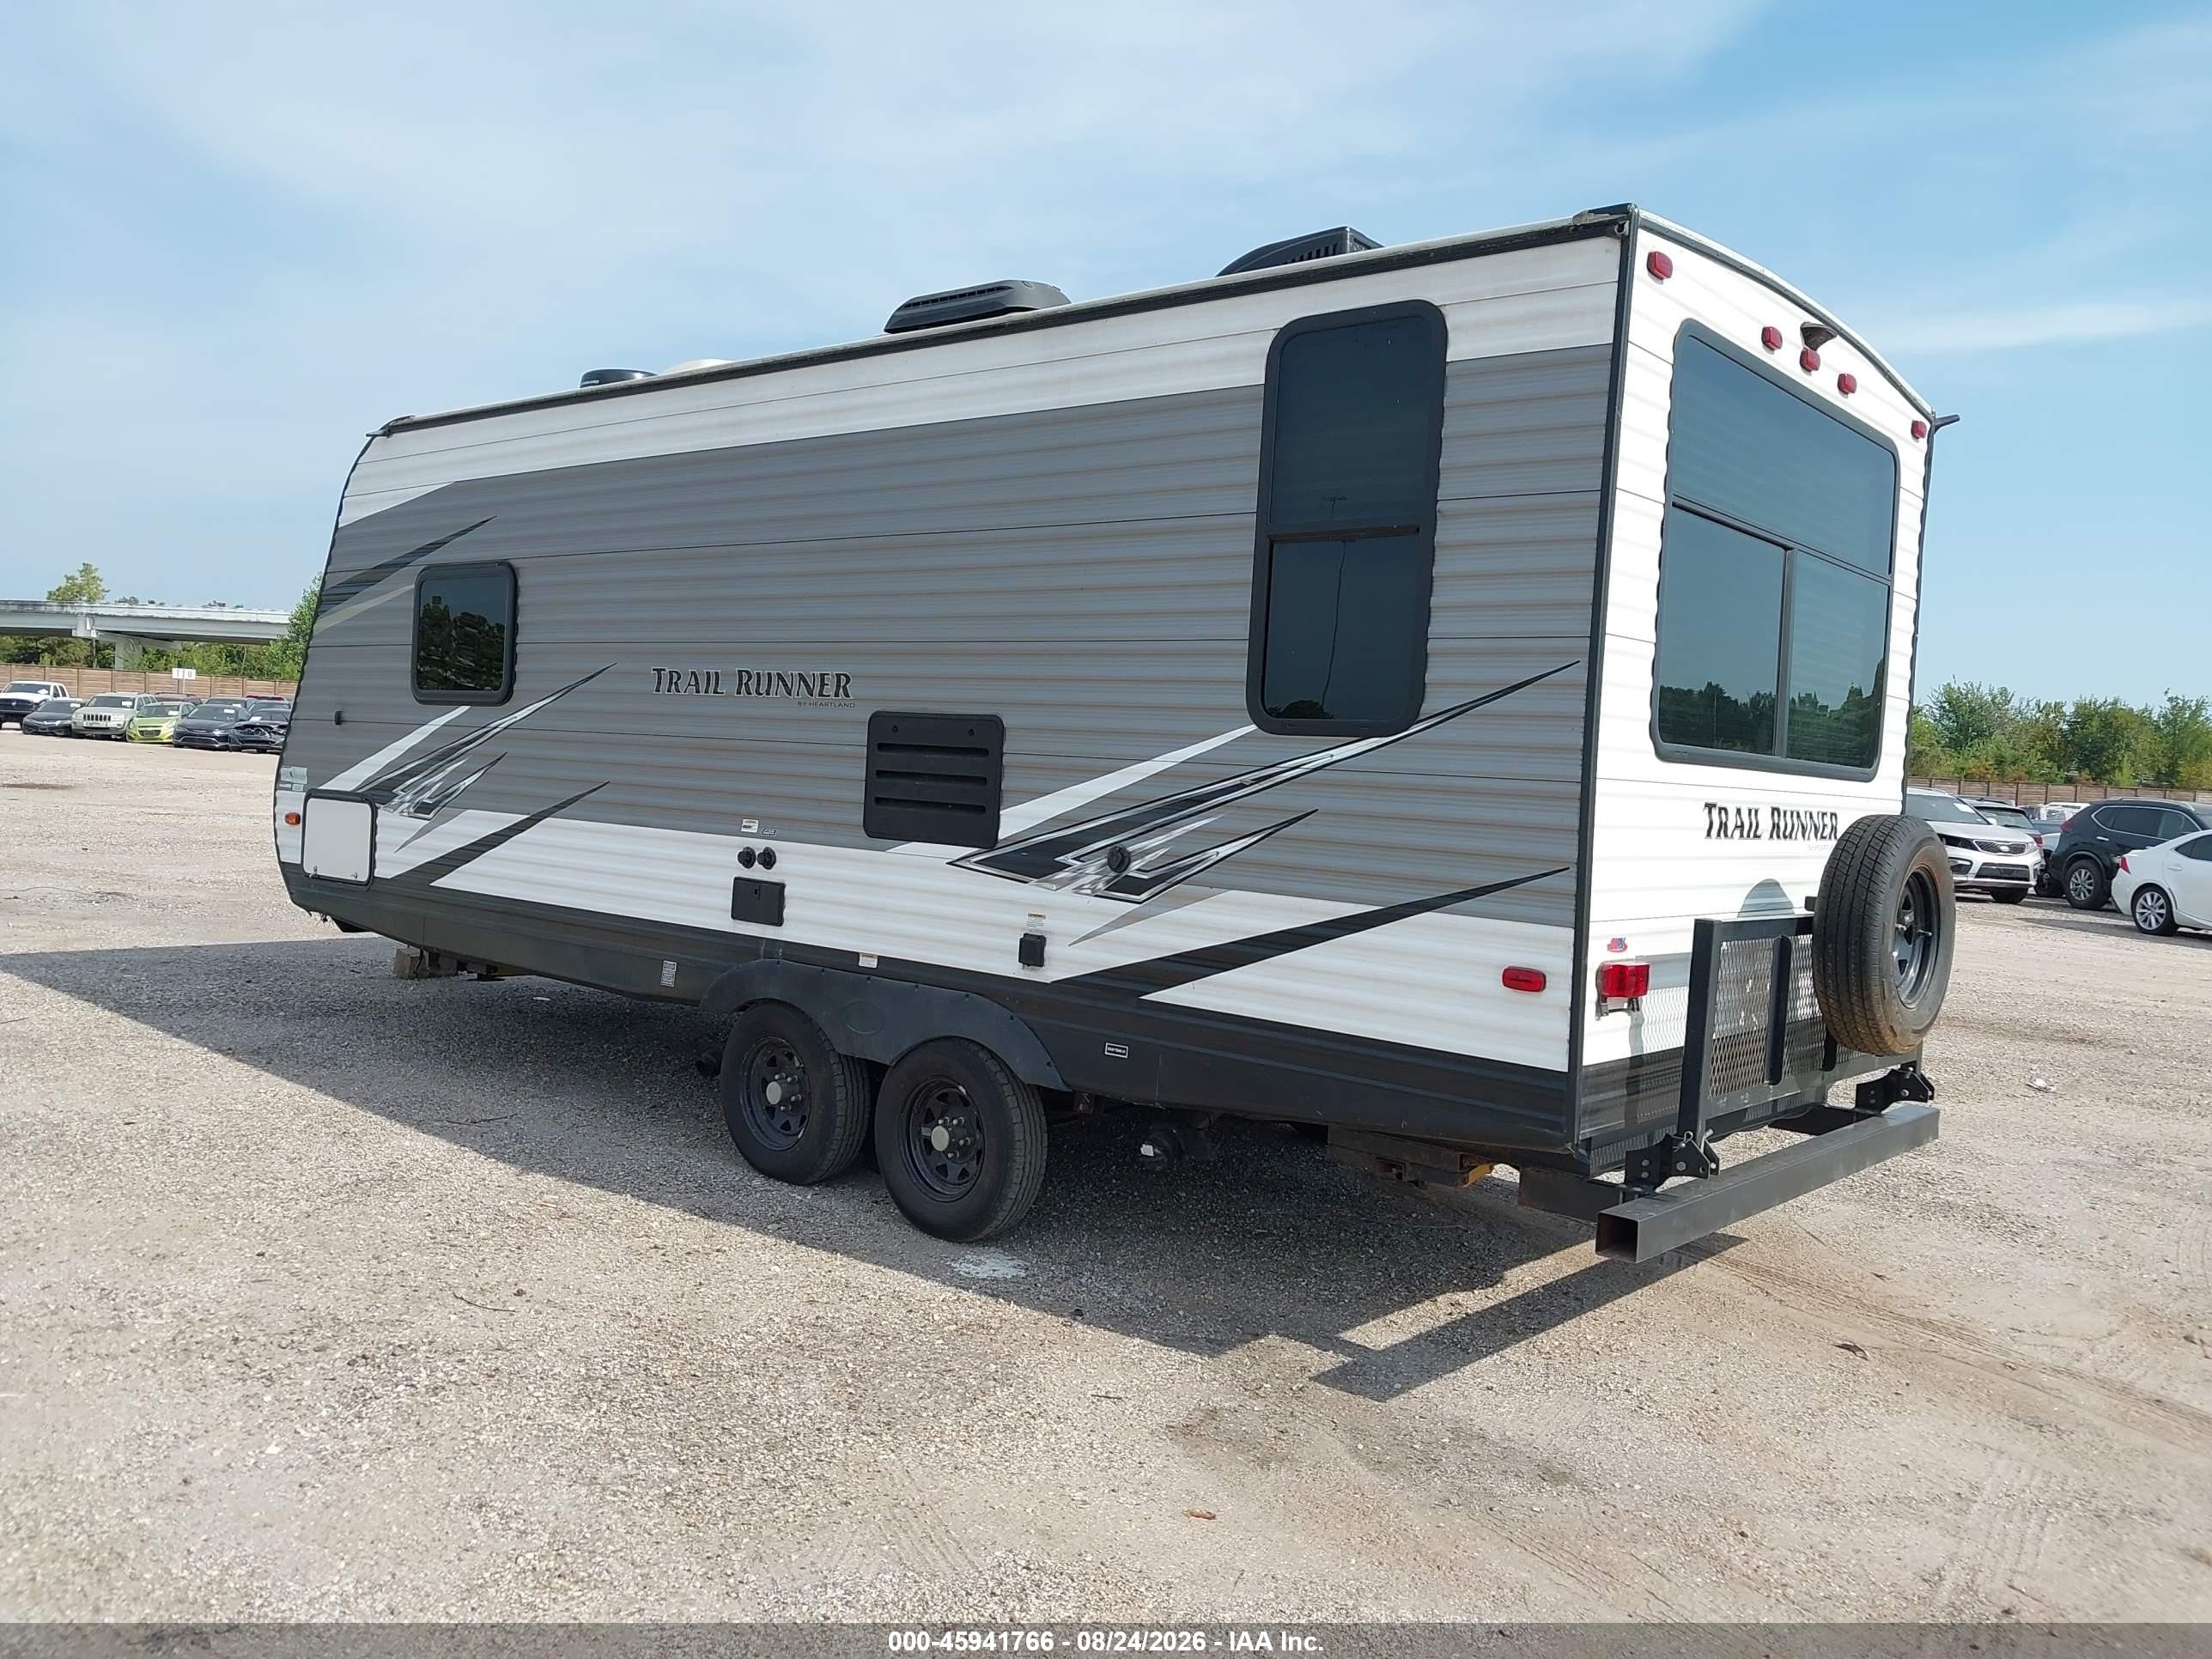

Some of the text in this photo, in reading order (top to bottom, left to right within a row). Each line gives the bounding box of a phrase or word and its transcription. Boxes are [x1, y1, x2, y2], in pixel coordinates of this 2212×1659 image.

[651, 666, 854, 700] TRAIL RUNNER
[1703, 801, 1839, 842] TRAIL RUNNER
